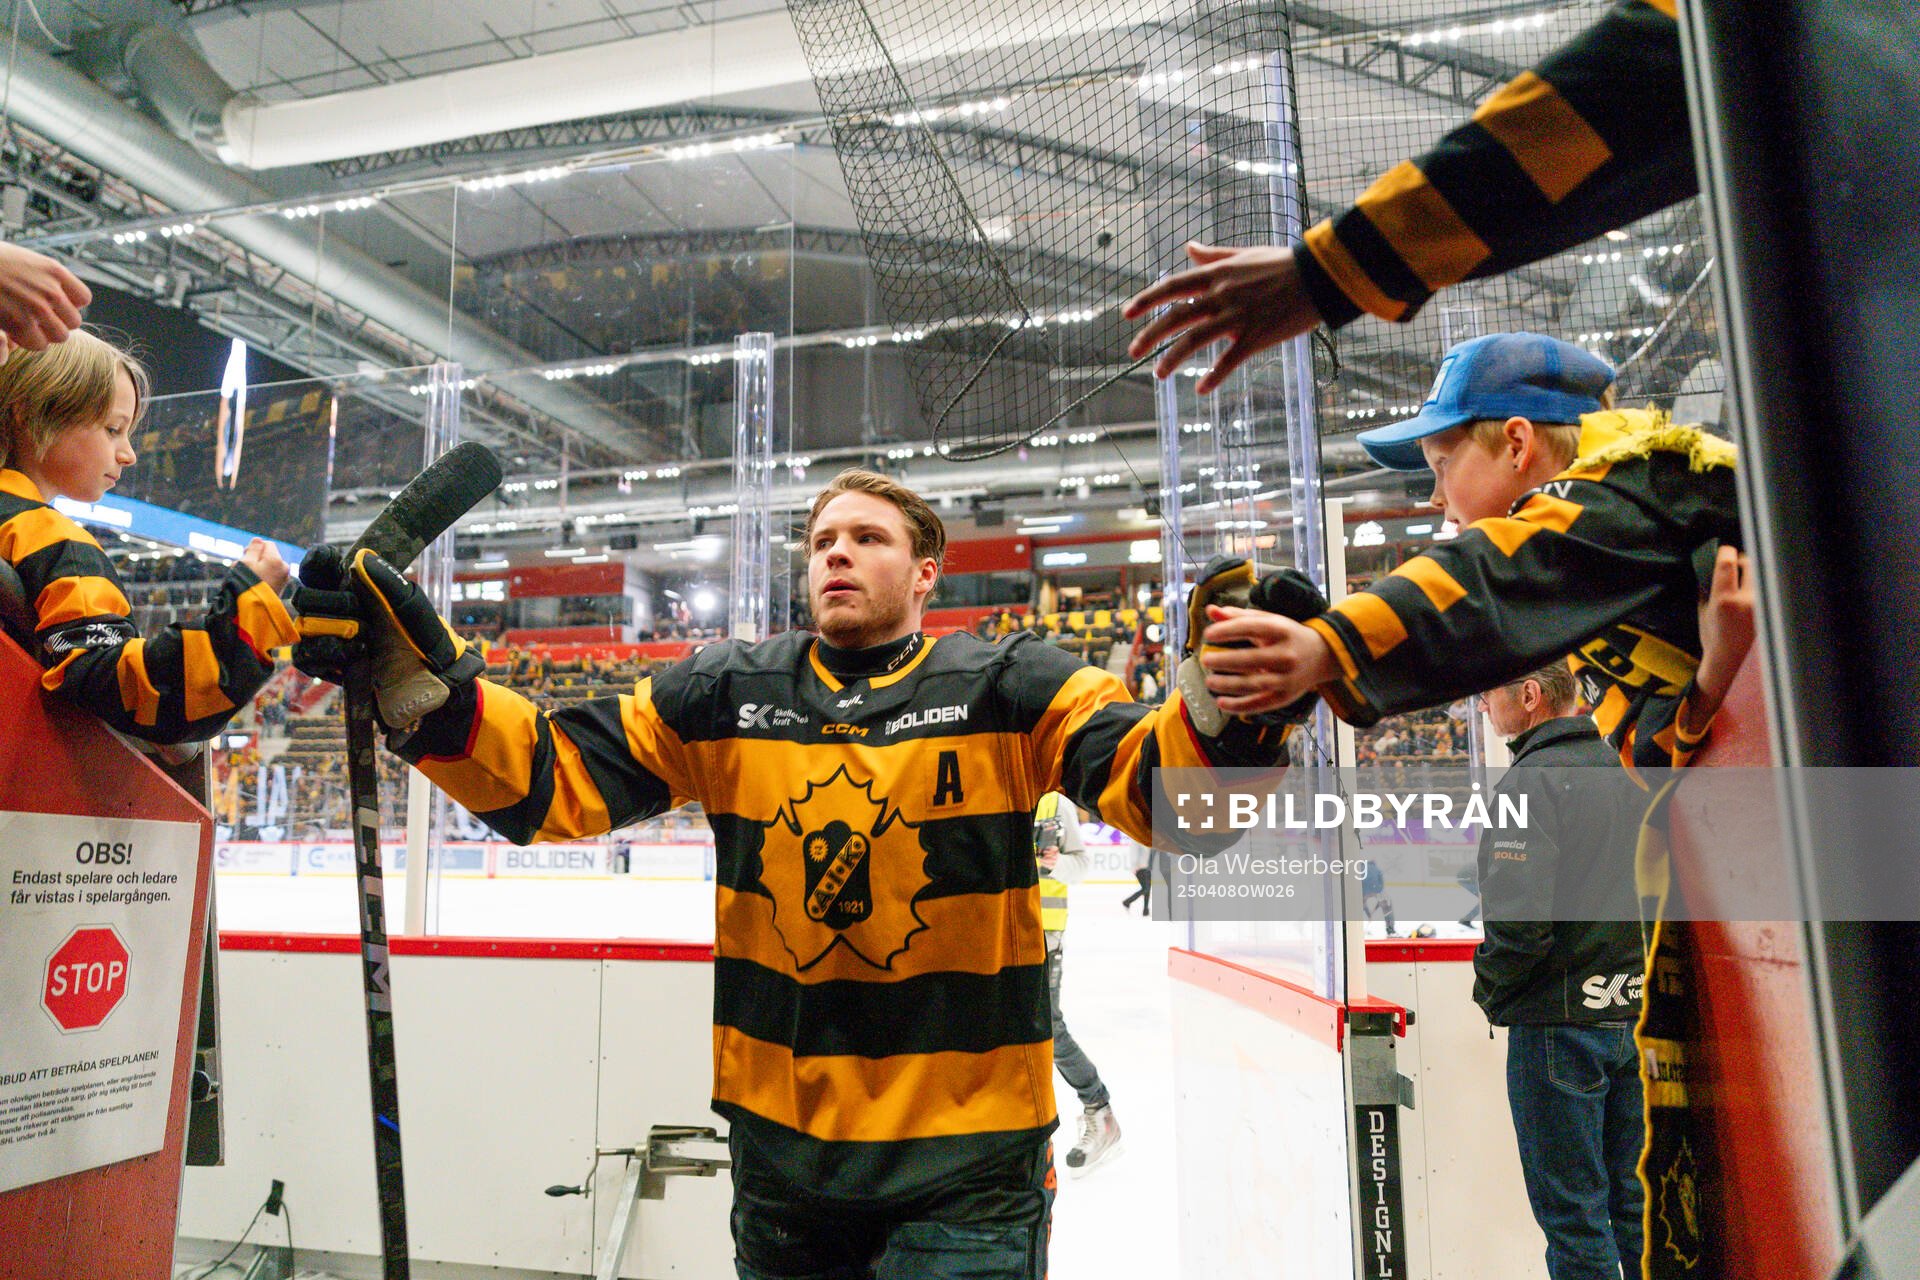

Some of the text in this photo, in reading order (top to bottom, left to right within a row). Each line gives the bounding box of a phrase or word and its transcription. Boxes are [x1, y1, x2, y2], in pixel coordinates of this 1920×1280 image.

[887, 633, 919, 672] CCM
[737, 703, 775, 729] SK
[772, 717, 791, 727] Kraft
[890, 704, 968, 735] BOLIDEN
[821, 723, 870, 737] CCM
[933, 750, 964, 806] A
[76, 841, 133, 865] OBS!
[506, 850, 596, 869] BOLIDEN
[12, 870, 178, 887] Endast spelare och ledare
[10, 889, 171, 905] får vistas i spelargången.
[838, 900, 864, 914] 1921
[51, 960, 124, 996] STOP
[1582, 973, 1630, 1009] SK
[29, 1069, 49, 1081] ATT
[51, 1060, 97, 1078] BETRÄDA
[99, 1050, 160, 1069] SPELPLANEN!
[42, 1087, 70, 1098] beträder
[33, 1100, 56, 1109] läktare
[57, 1096, 70, 1104] och
[50, 1117, 60, 1125] att
[16, 1132, 36, 1142] under
[37, 1128, 48, 1137] två
[1368, 1111, 1393, 1280] DESIGNL
